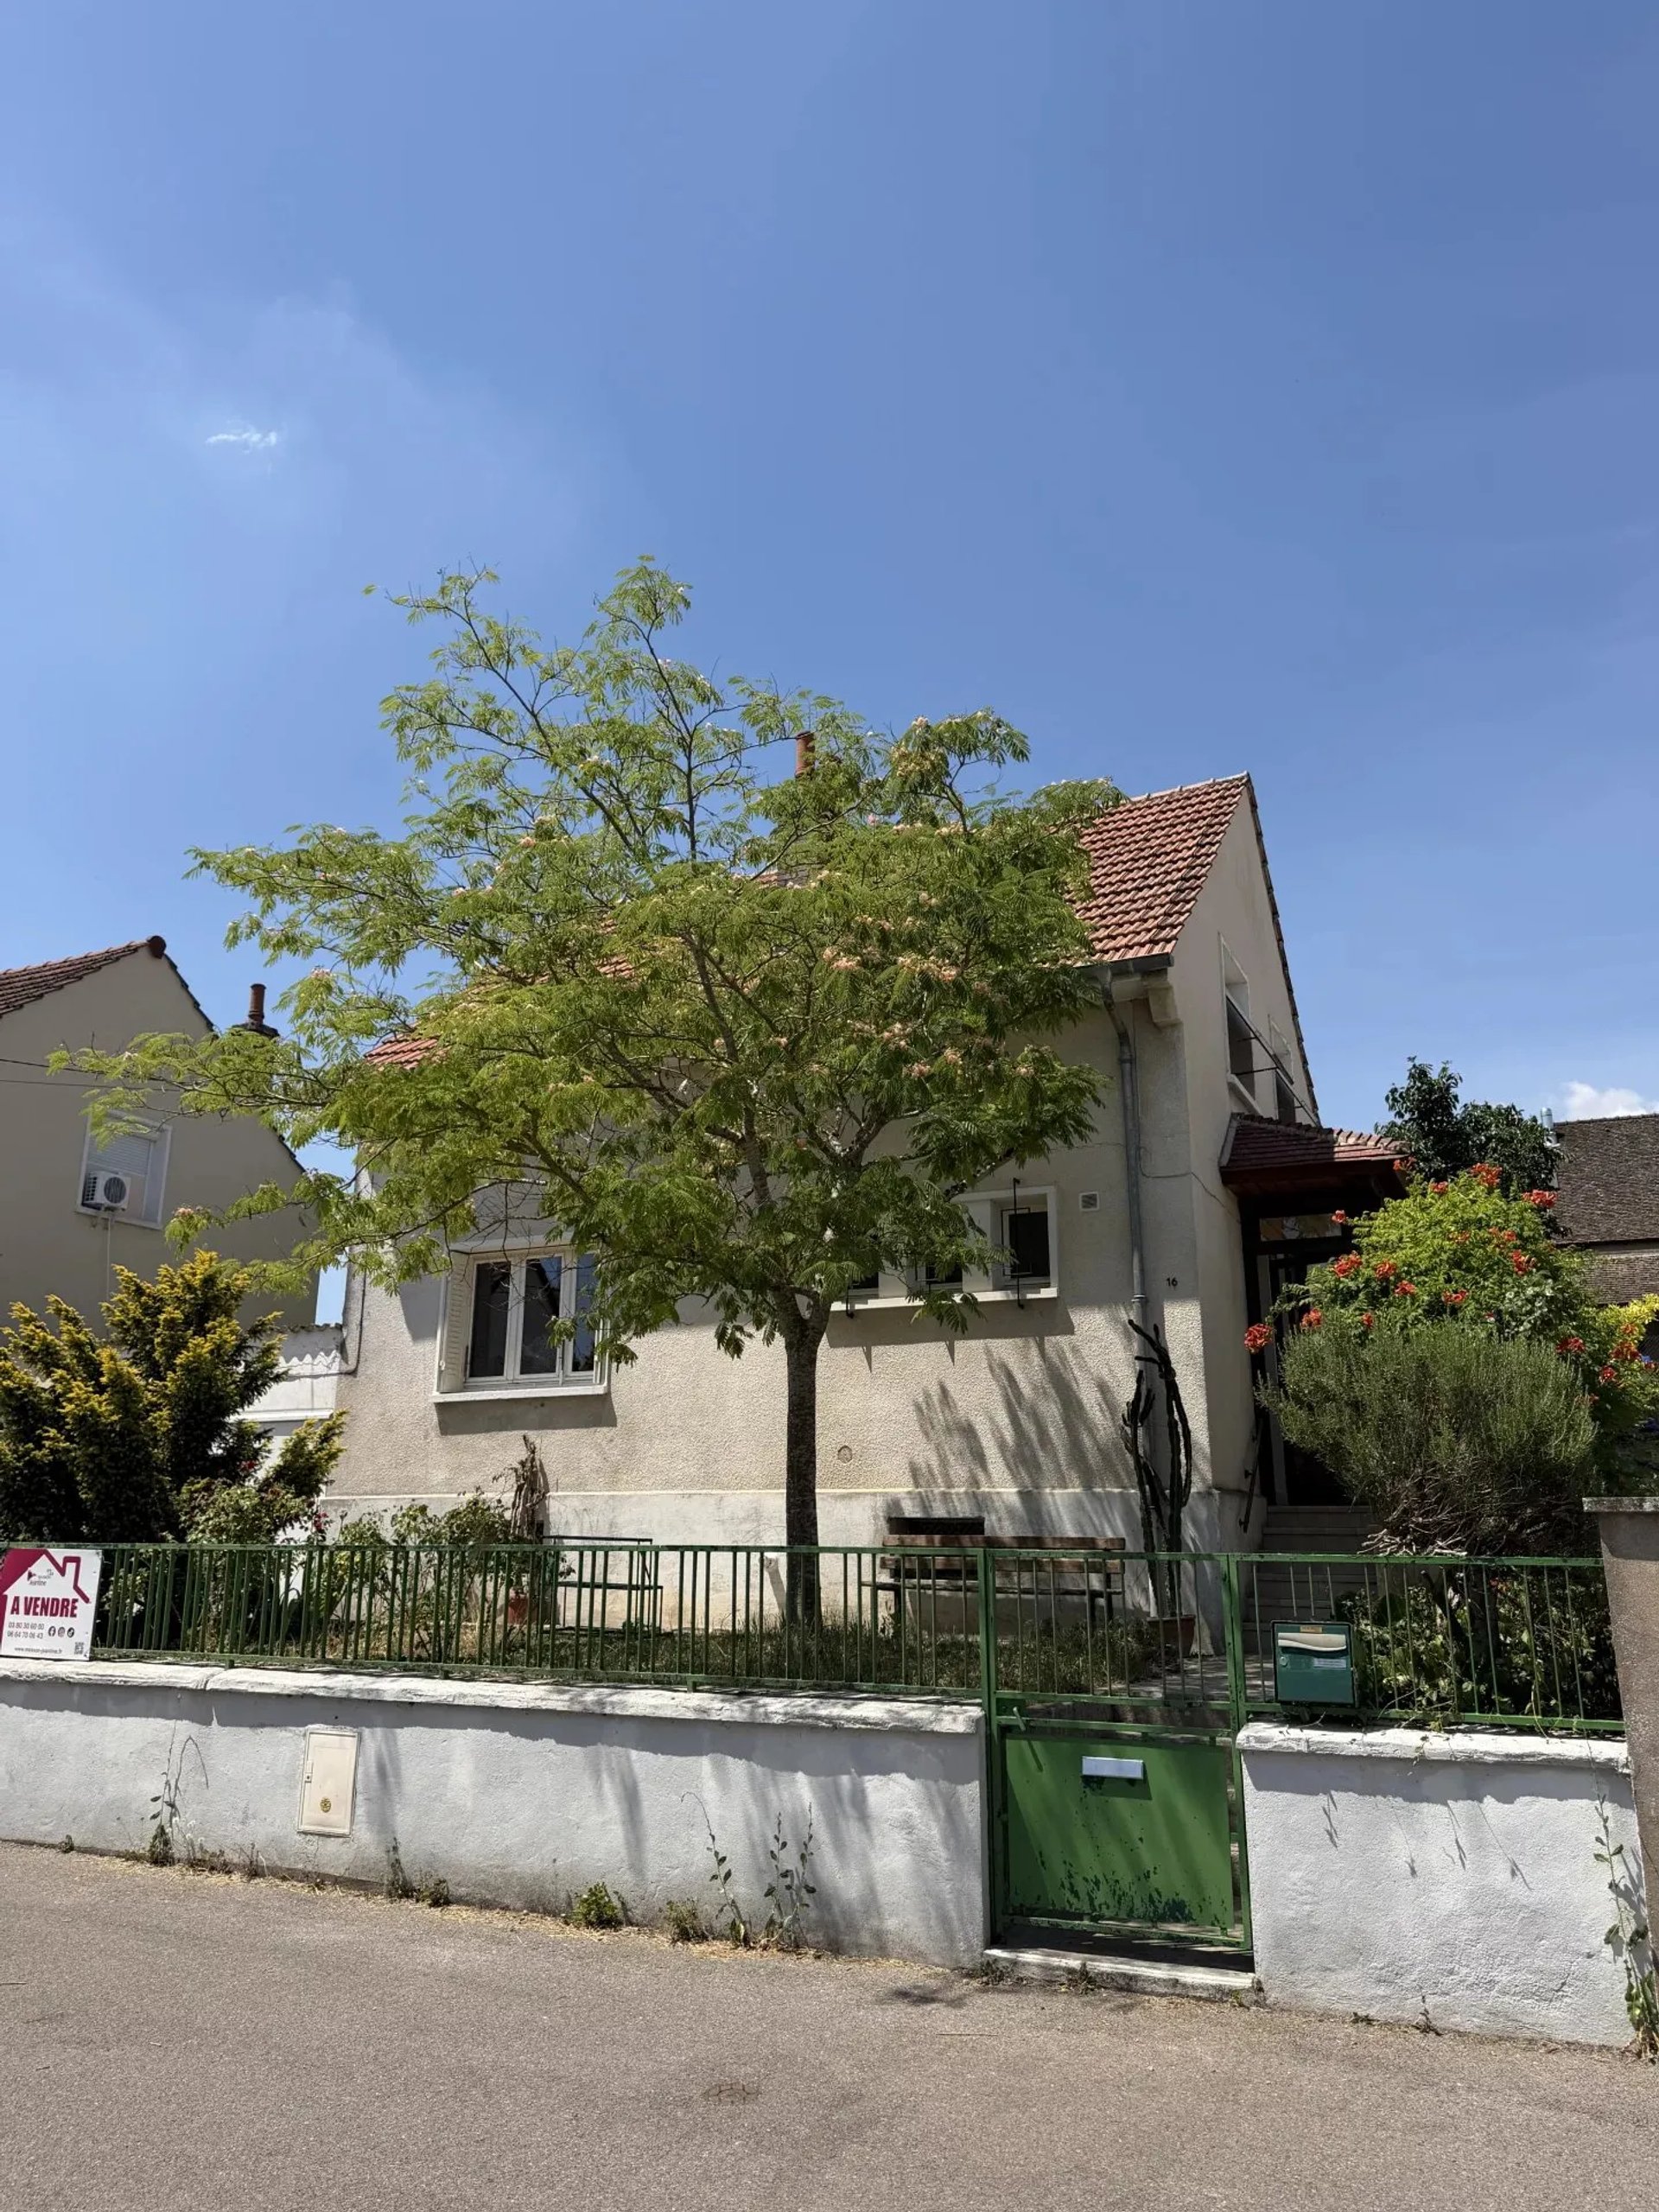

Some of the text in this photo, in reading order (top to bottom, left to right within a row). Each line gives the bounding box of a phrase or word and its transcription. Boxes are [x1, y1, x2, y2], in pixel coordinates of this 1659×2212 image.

[1166, 1277, 1178, 1287] 16
[10, 1596, 79, 1618] A VENDRE
